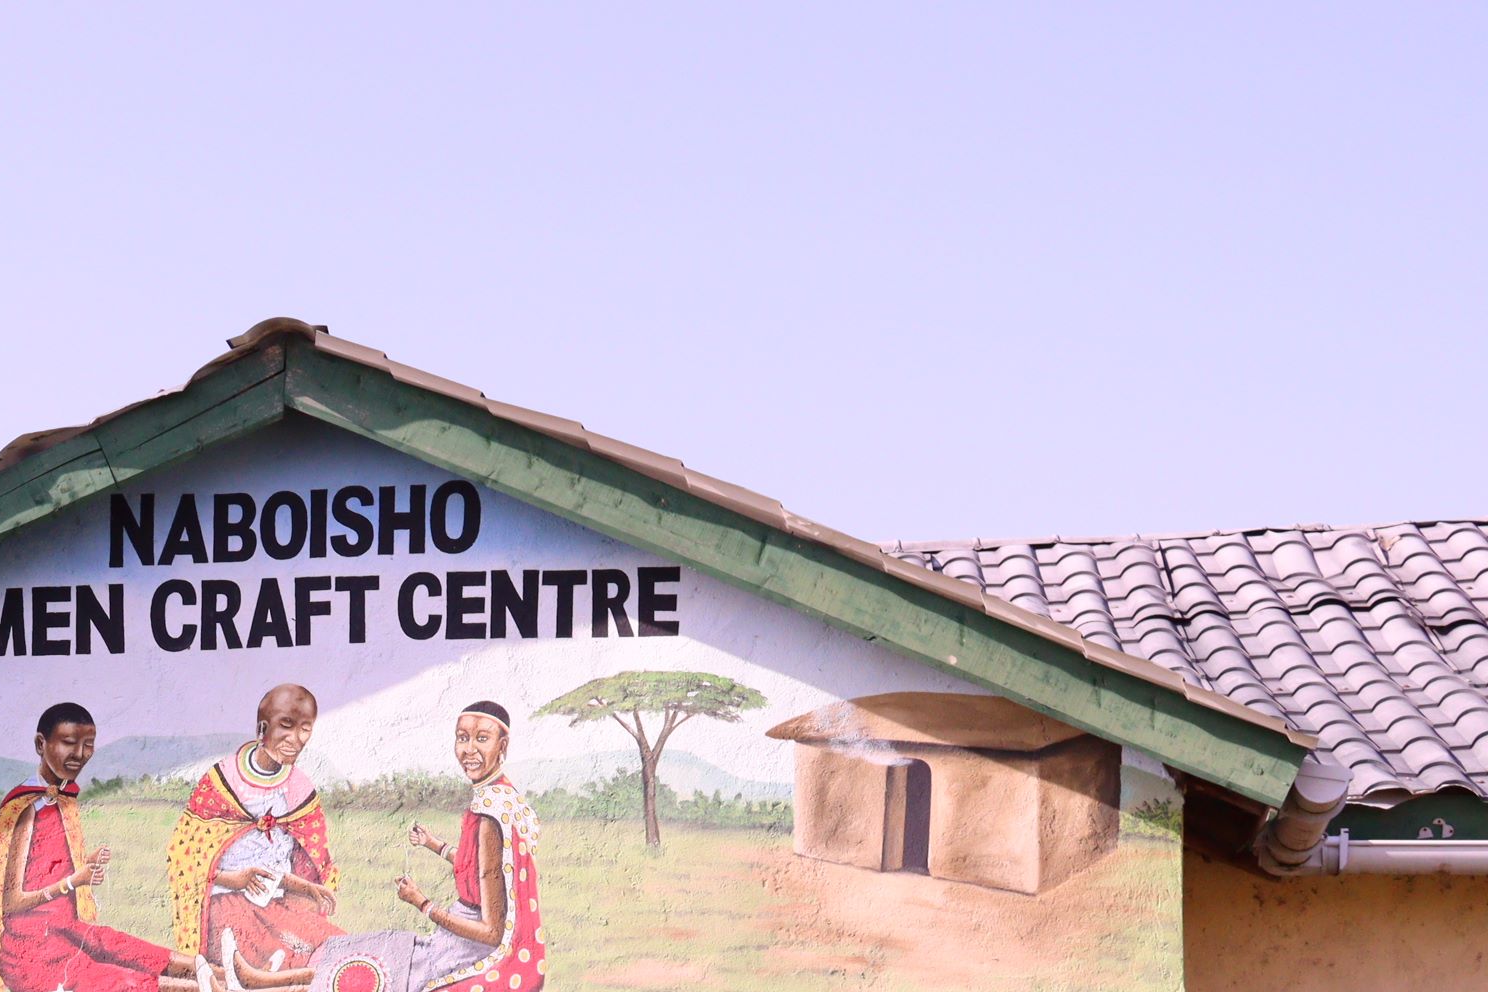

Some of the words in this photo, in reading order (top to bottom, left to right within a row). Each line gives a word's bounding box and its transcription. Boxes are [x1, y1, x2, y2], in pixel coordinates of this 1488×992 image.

[109, 480, 481, 568] NABOISHO
[151, 576, 379, 652] CRAFT
[398, 566, 680, 640] CENTRE
